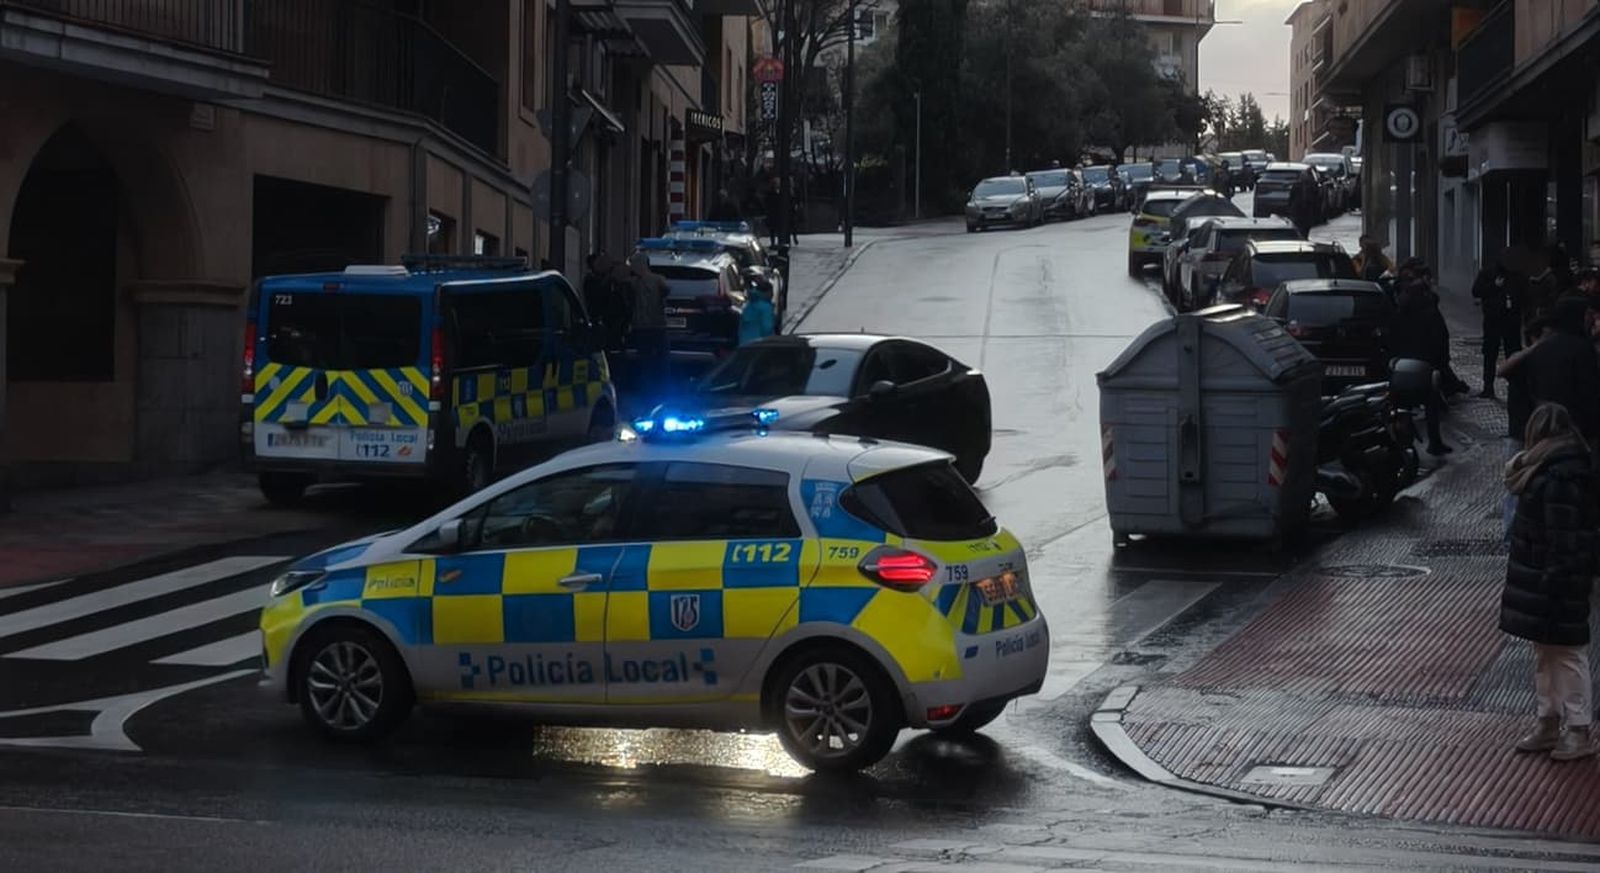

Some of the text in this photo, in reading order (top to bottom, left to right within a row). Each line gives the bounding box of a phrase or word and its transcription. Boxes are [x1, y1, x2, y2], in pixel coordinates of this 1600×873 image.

[828, 546, 860, 560] 759
[945, 564, 969, 581] 759
[605, 651, 689, 684] Local
